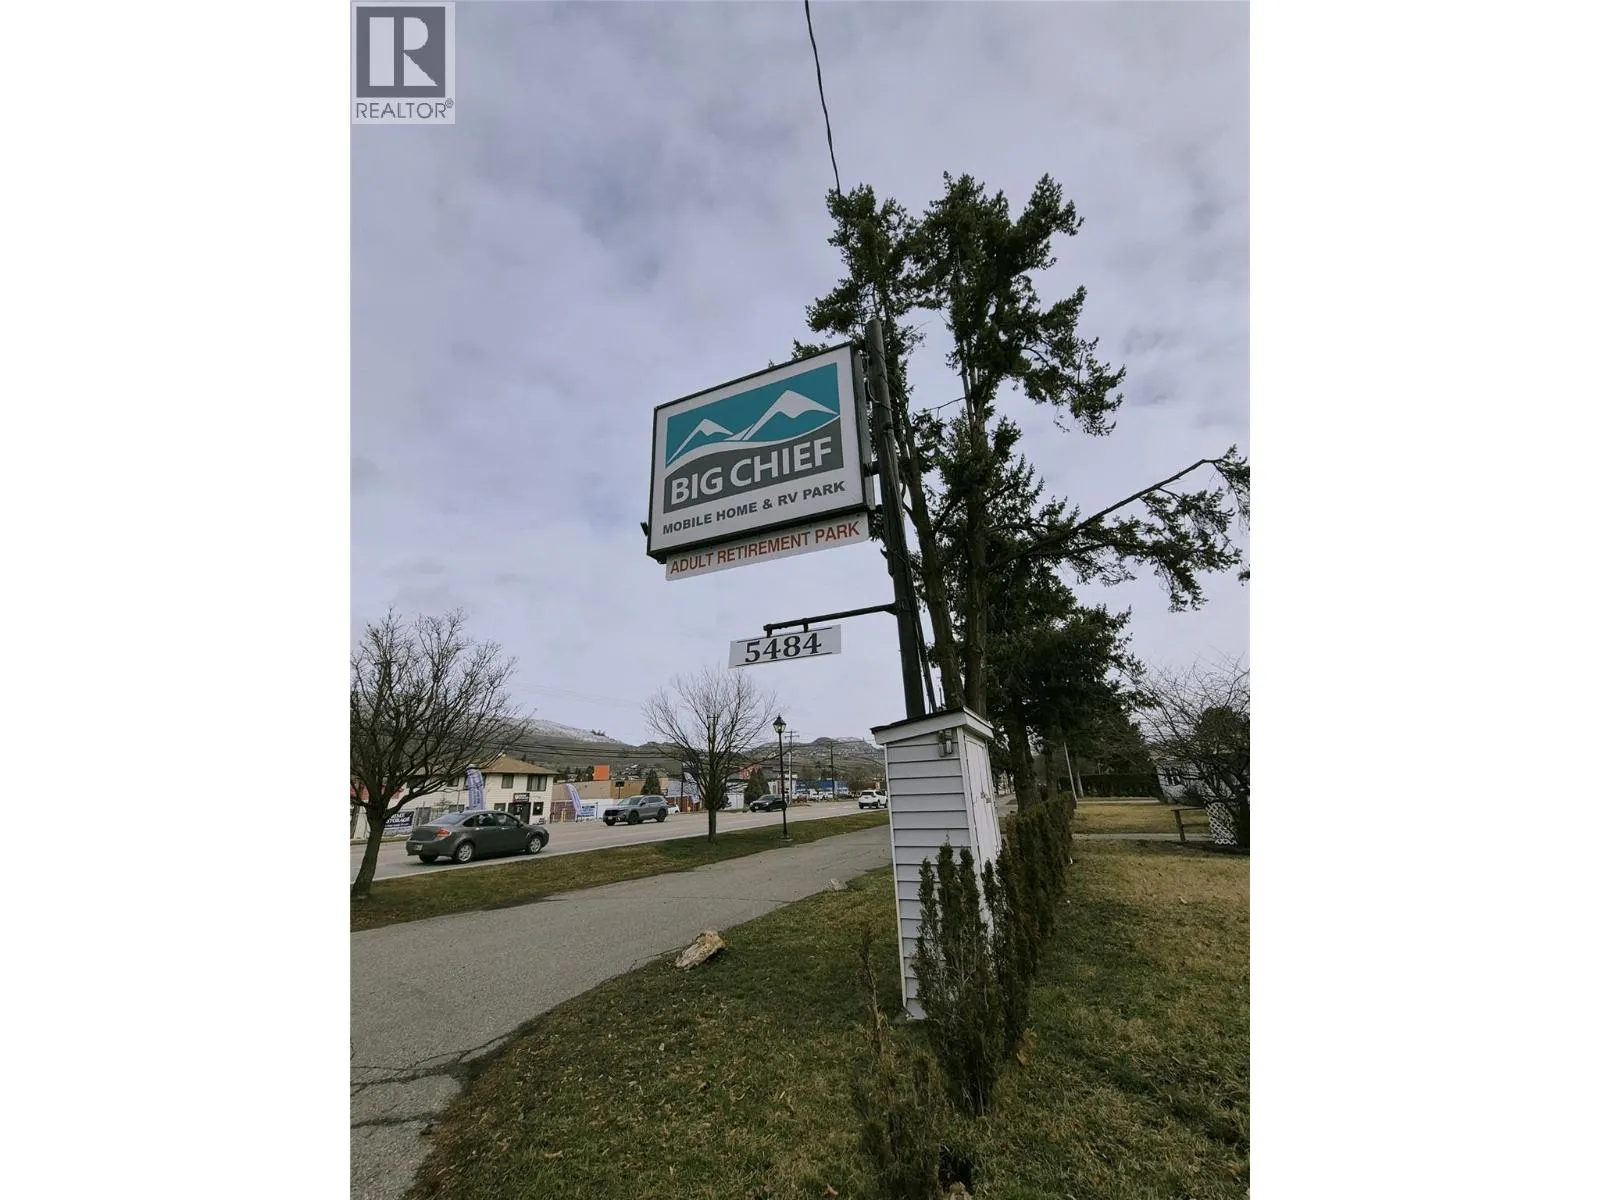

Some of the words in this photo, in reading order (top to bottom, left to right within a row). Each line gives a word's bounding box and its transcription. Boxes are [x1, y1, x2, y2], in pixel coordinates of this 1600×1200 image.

[670, 466, 723, 505] BIG
[730, 436, 832, 487] CHIEF
[662, 513, 712, 535] MOBILE
[716, 502, 758, 521] HOME
[762, 498, 773, 510] &
[778, 491, 798, 507] RV
[803, 480, 846, 501] PARK
[670, 552, 714, 575] ADULT
[717, 531, 811, 565] RETIREMENT
[815, 520, 860, 544] PARK
[744, 632, 822, 663] 5484
